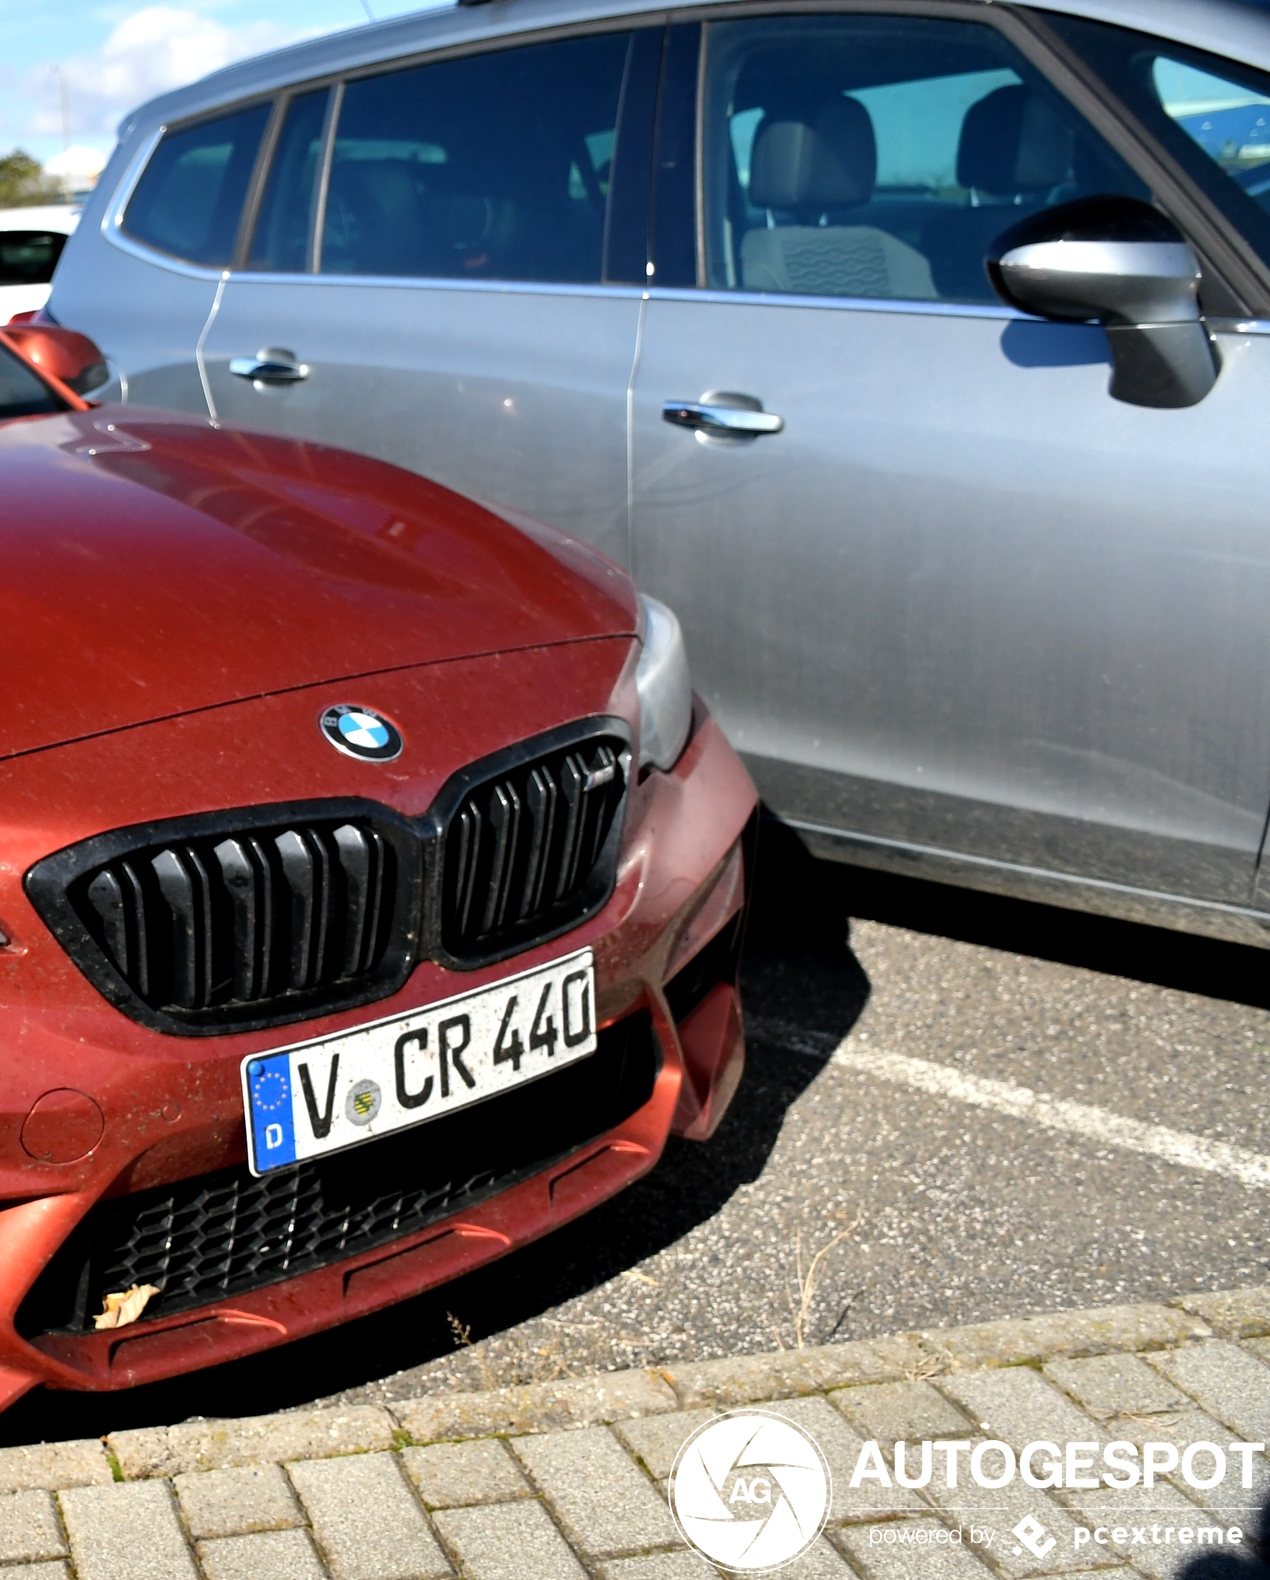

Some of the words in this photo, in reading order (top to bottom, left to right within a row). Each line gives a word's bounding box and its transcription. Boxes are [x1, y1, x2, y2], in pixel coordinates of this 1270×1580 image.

[323, 705, 378, 728] BMW
[298, 1053, 340, 1139] V
[393, 1013, 476, 1109] CR
[493, 969, 591, 1071] 440
[265, 1122, 283, 1150] D
